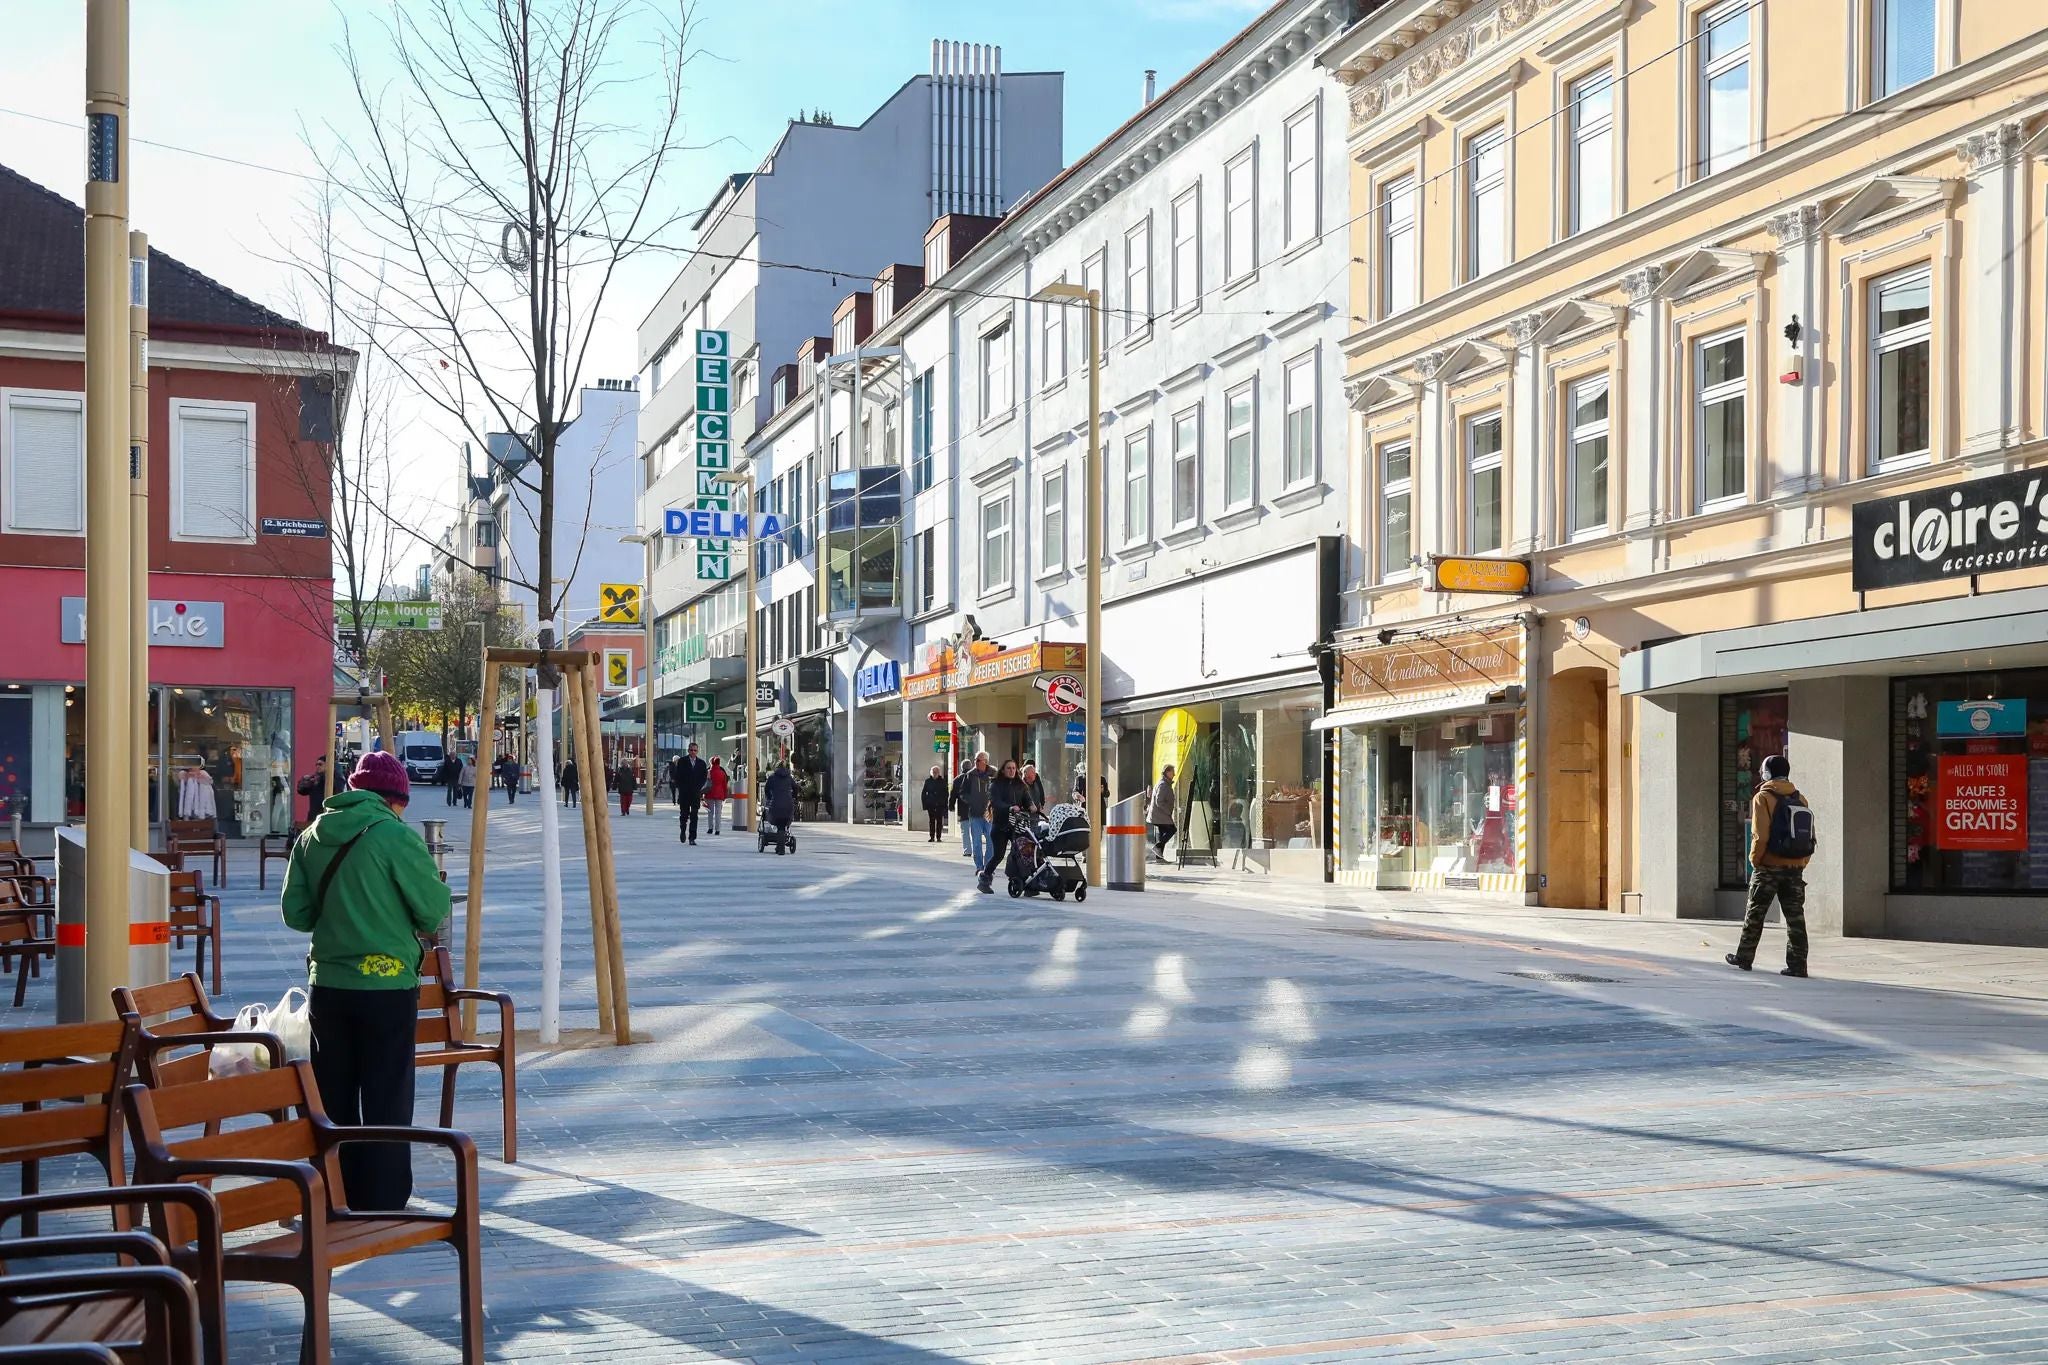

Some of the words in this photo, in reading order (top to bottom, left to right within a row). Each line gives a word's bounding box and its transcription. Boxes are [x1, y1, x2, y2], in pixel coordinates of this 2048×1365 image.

[276, 521, 324, 529] Krichbaum-
[666, 510, 784, 540] DELKA
[78, 603, 208, 640] kie
[975, 660, 1000, 679] PFEIFEN
[1003, 653, 1031, 673] FISCHER
[857, 661, 896, 697] DELKA
[1054, 676, 1080, 693] TABAK
[693, 698, 709, 714] D
[1049, 692, 1075, 712] TRAFIK
[1954, 764, 1974, 776] ALLES
[1976, 764, 1984, 776] IM
[1986, 763, 2009, 776] STORE!
[1956, 786, 1996, 797] KAUFE
[1998, 785, 2006, 796] 3
[1945, 799, 2007, 810] BEKOMME
[2009, 799, 2017, 809] 3
